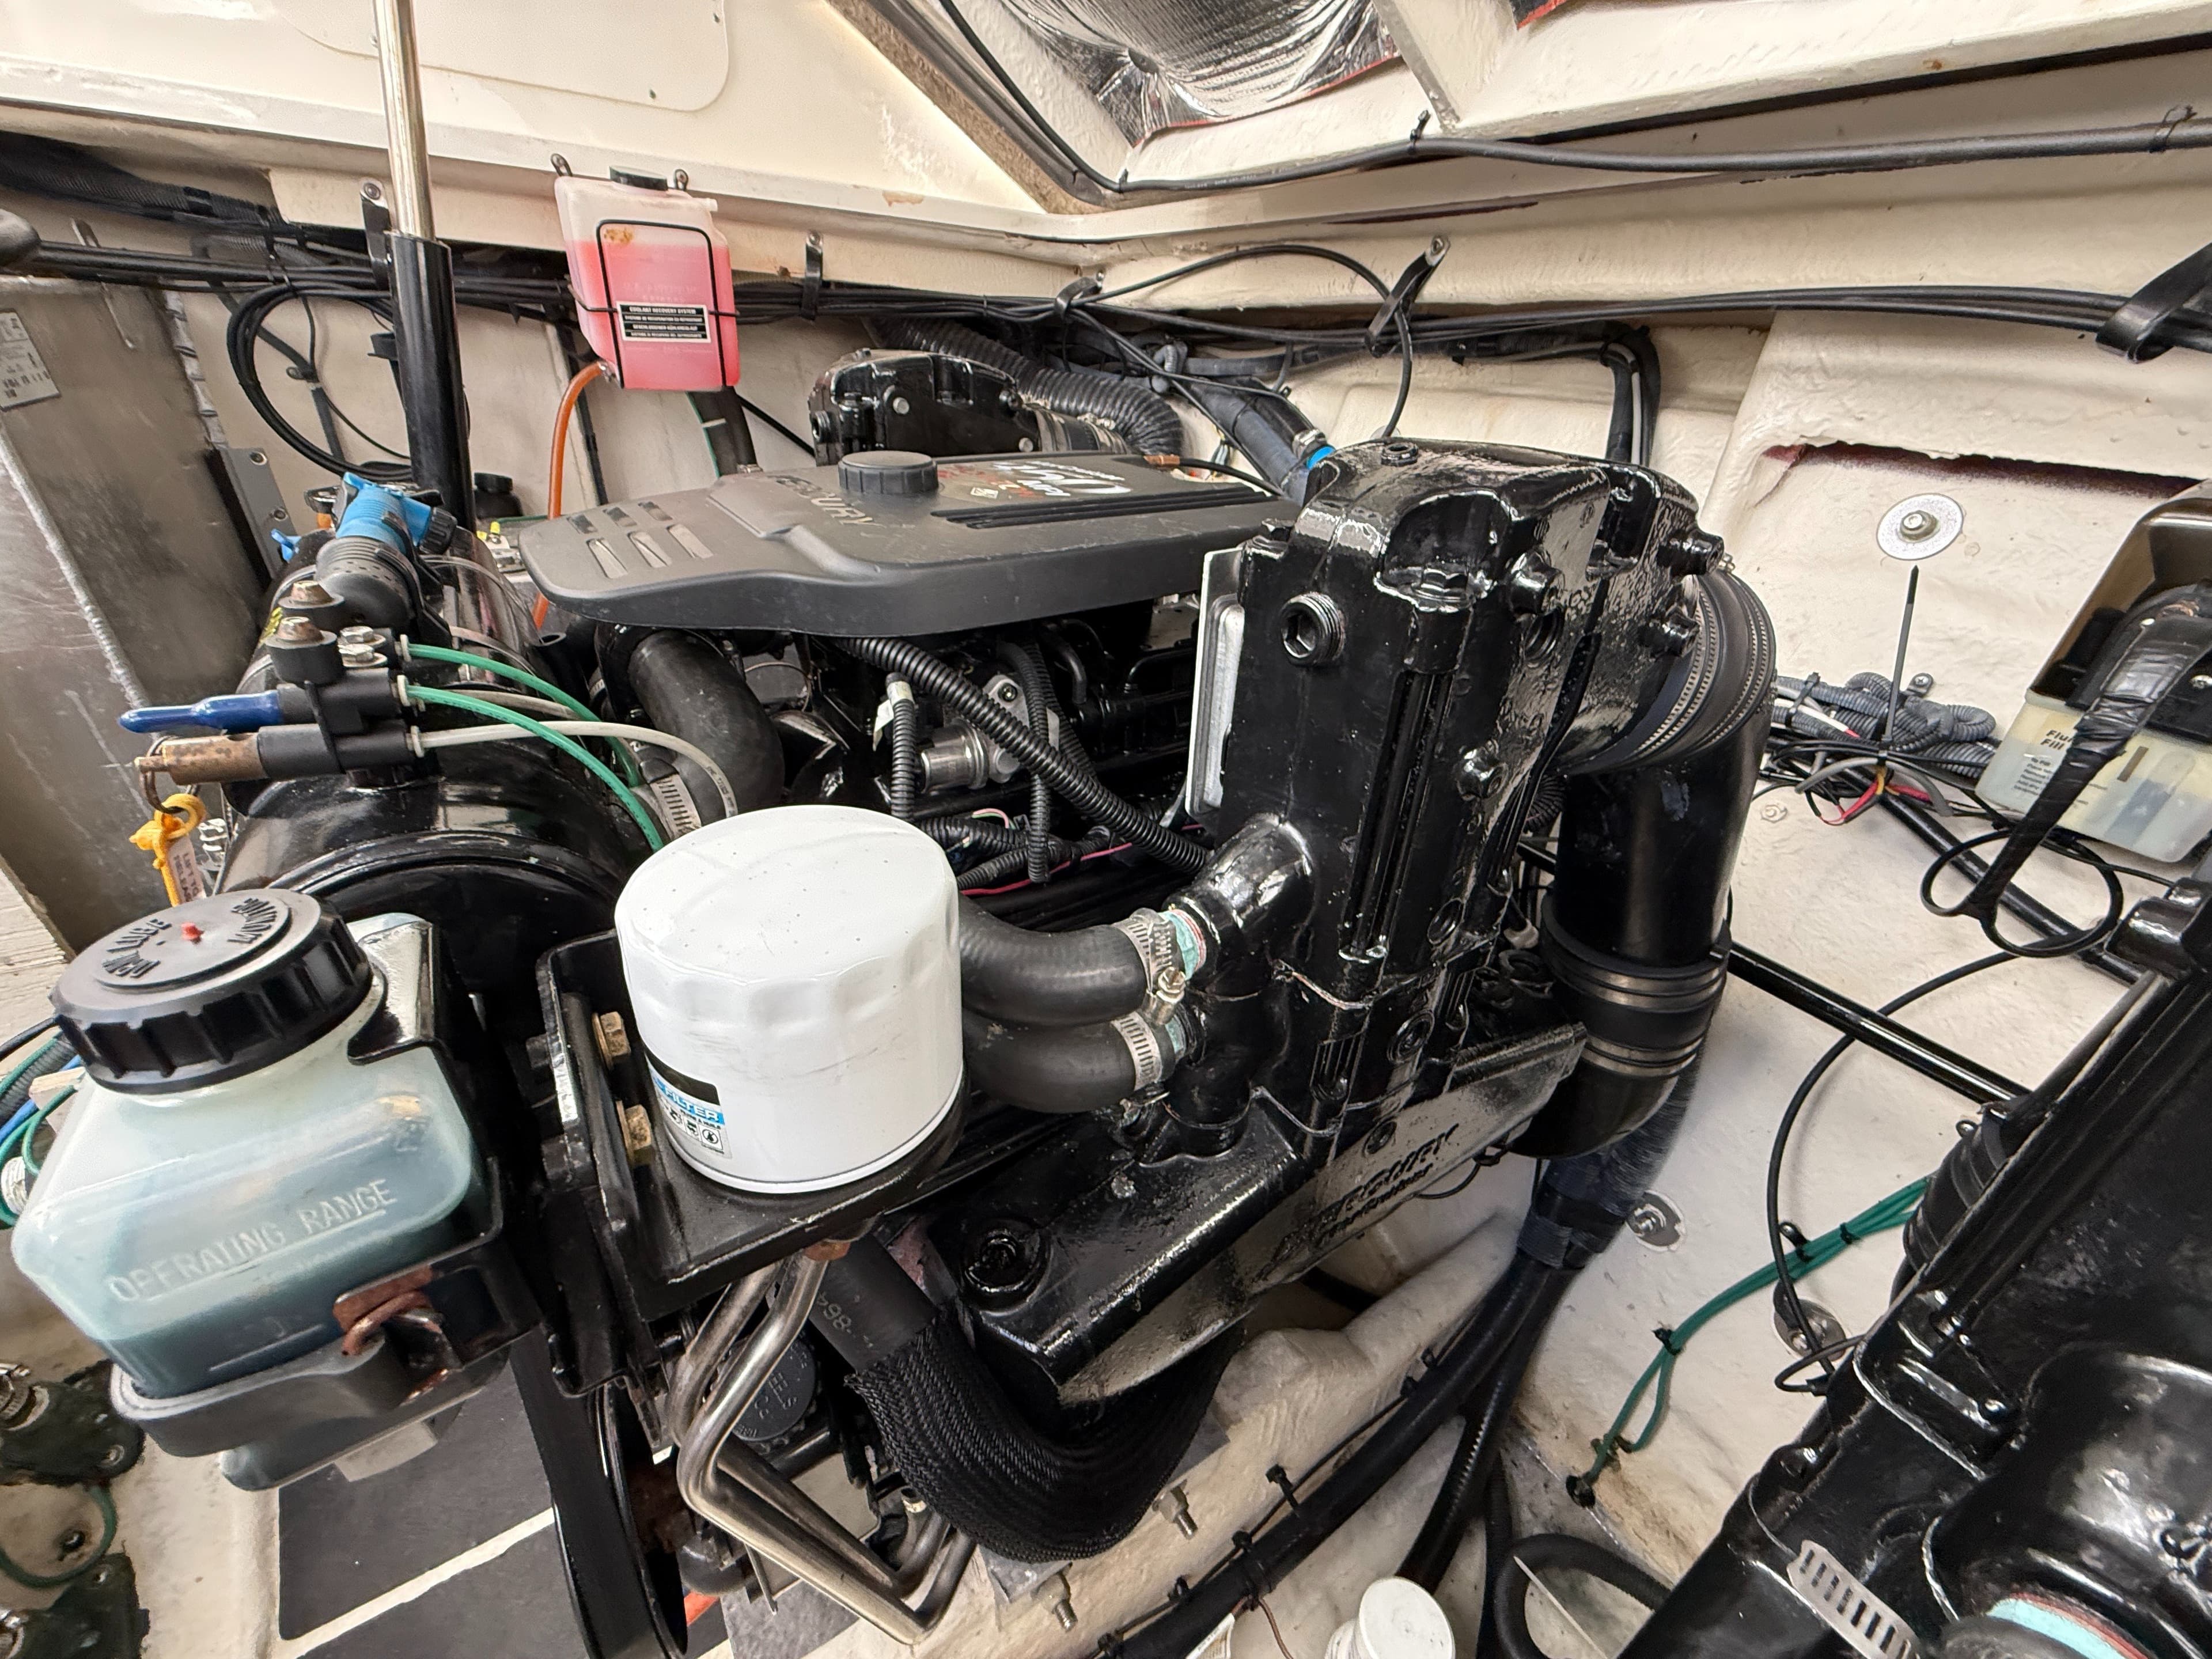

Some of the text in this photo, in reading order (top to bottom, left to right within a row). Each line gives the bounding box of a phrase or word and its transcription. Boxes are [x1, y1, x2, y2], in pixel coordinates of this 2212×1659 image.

[2040, 738, 2065, 750] Fill
[664, 1086, 720, 1122] FILTER
[109, 1179, 397, 1302] OPERATING RANGE
